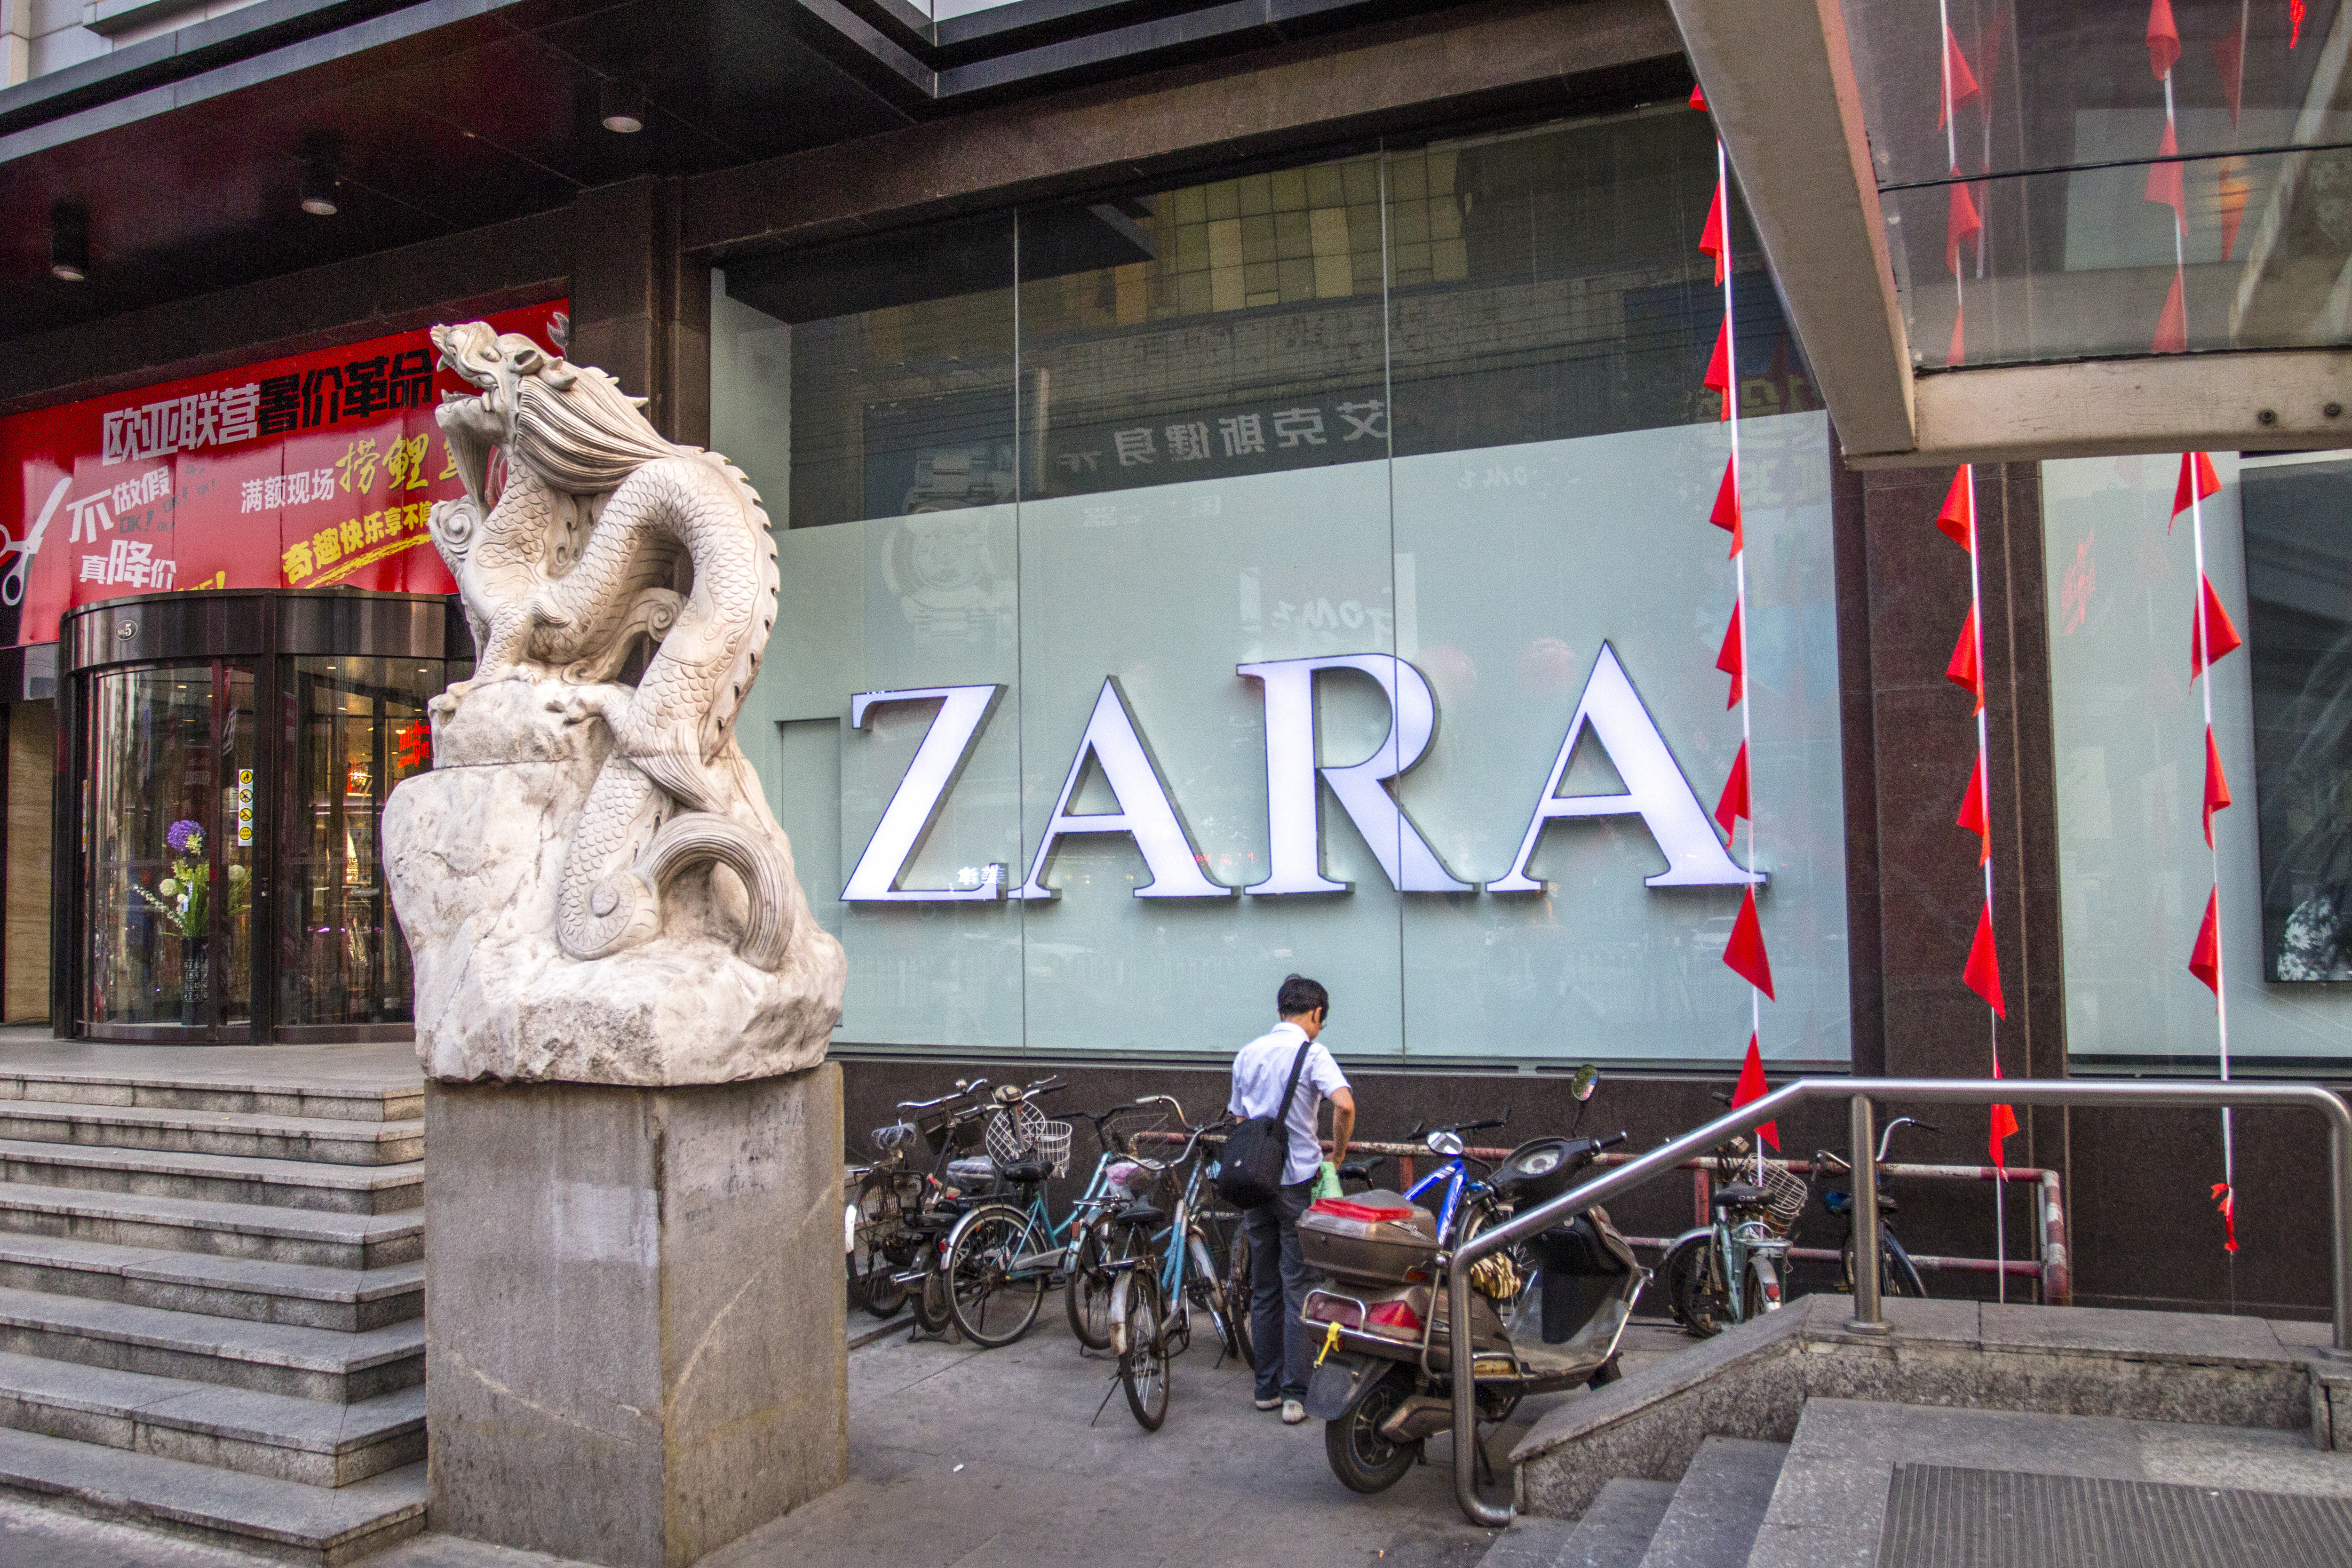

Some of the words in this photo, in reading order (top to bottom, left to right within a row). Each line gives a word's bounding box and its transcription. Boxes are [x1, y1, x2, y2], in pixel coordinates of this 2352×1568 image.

[66, 465, 170, 543] 不做假
[241, 468, 334, 513] 满额现场
[119, 509, 154, 533] OK!
[79, 539, 176, 589] 真降价
[840, 639, 1770, 902] ZARA
